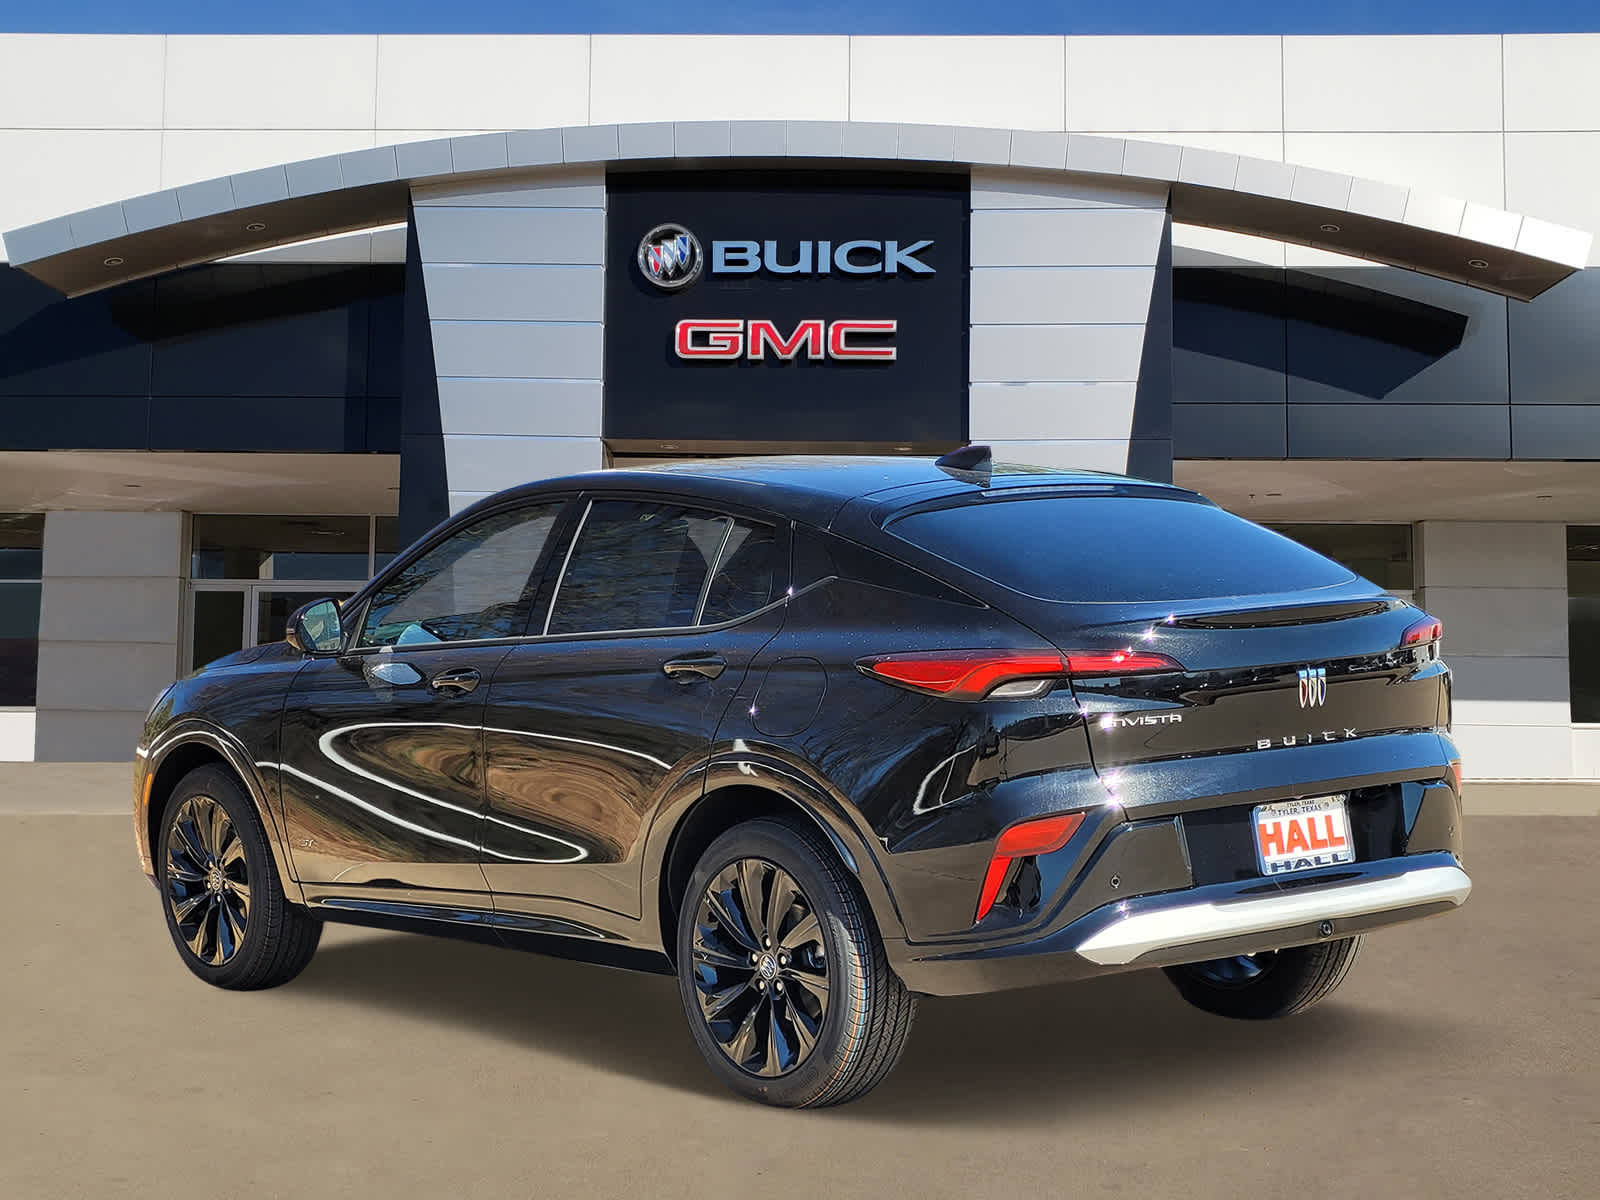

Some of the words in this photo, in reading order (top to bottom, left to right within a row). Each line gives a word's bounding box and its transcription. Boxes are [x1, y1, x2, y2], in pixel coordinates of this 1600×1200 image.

[711, 240, 937, 273] BUICK
[675, 319, 897, 360] GMC
[1257, 727, 1358, 749] BUICK
[1302, 804, 1322, 813] TEXAS
[1258, 814, 1345, 857] HALL
[1270, 853, 1349, 873] HALL
